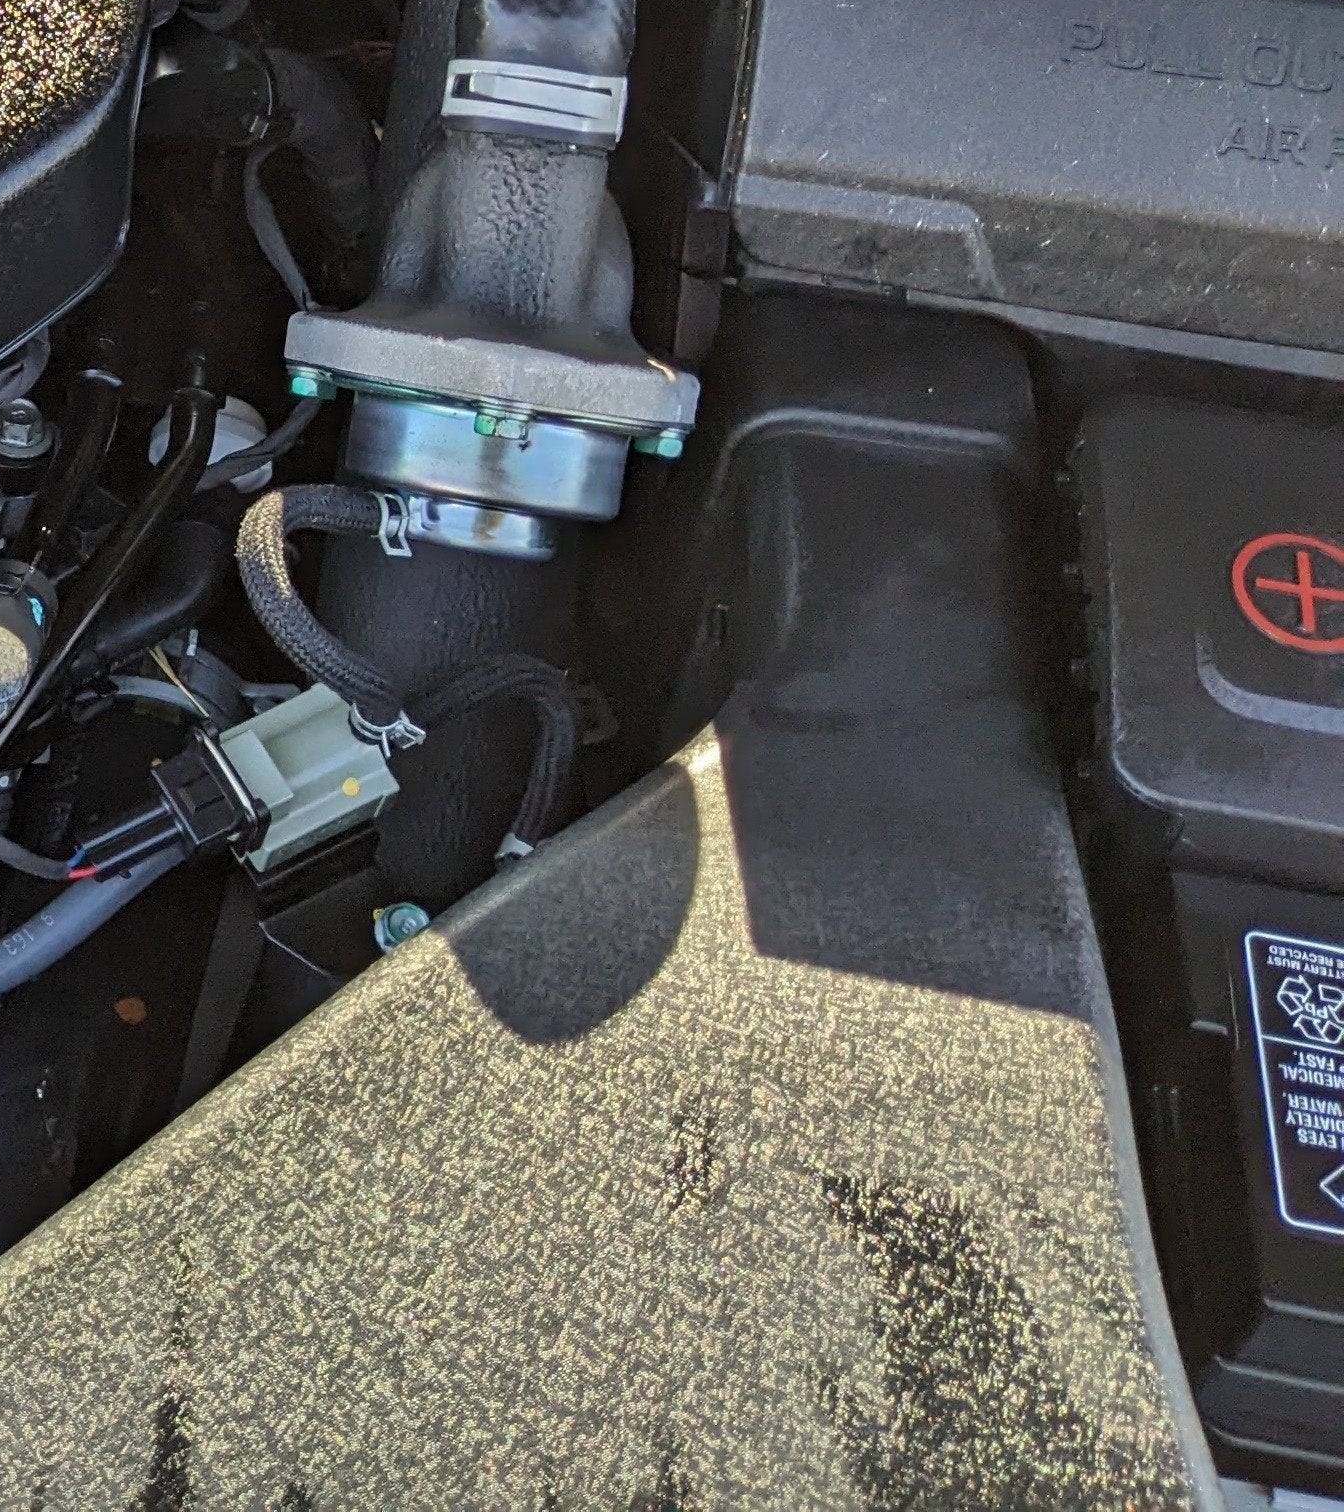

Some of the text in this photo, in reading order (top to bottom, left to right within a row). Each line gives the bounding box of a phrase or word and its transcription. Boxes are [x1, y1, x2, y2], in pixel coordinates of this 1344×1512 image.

[1061, 18, 1224, 80] PULL
[1215, 120, 1308, 167] AIR
[1267, 954, 1302, 971] MUST
[1269, 944, 1334, 968] RECYCLED
[1292, 1050, 1335, 1072] FAST.
[1296, 1128, 1338, 1150] EYES
